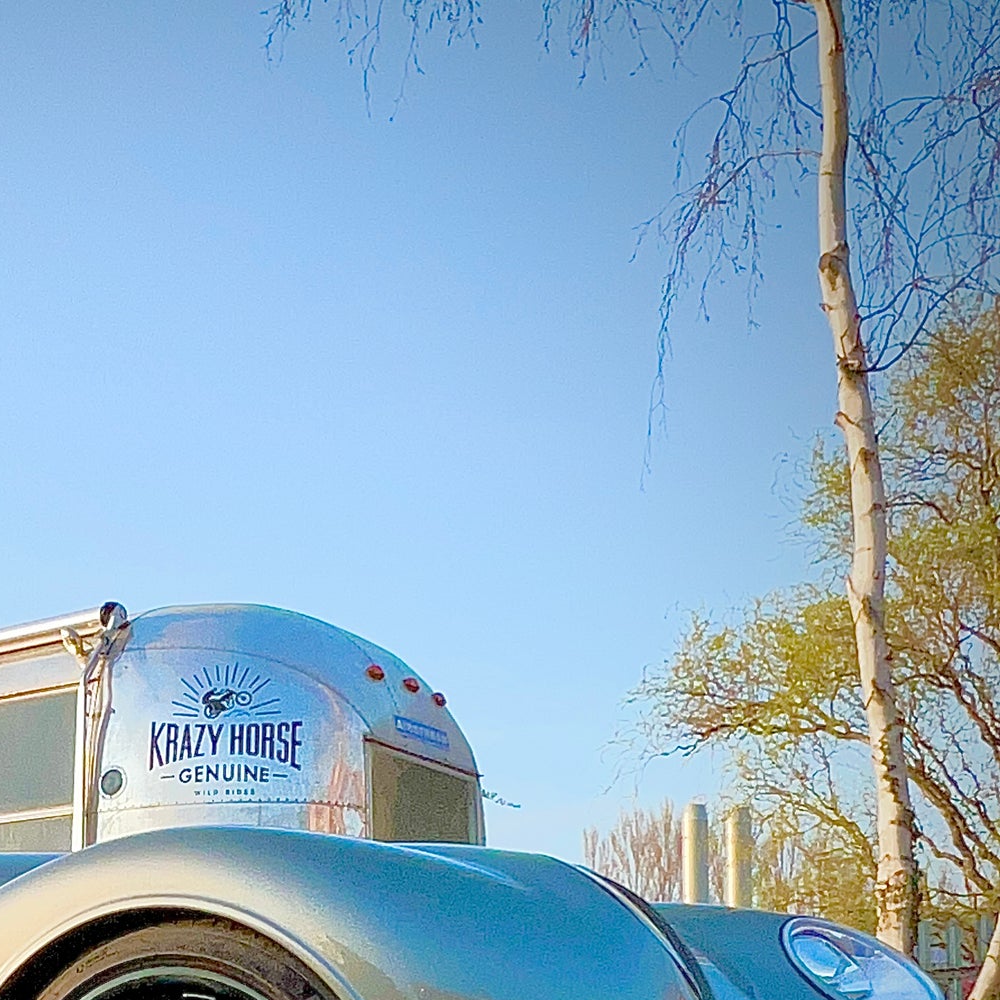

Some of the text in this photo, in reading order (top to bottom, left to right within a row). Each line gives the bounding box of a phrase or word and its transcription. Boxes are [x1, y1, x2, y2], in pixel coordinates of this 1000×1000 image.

[149, 720, 303, 771] KRAZY HORSE
[178, 763, 270, 784] GENUINE
